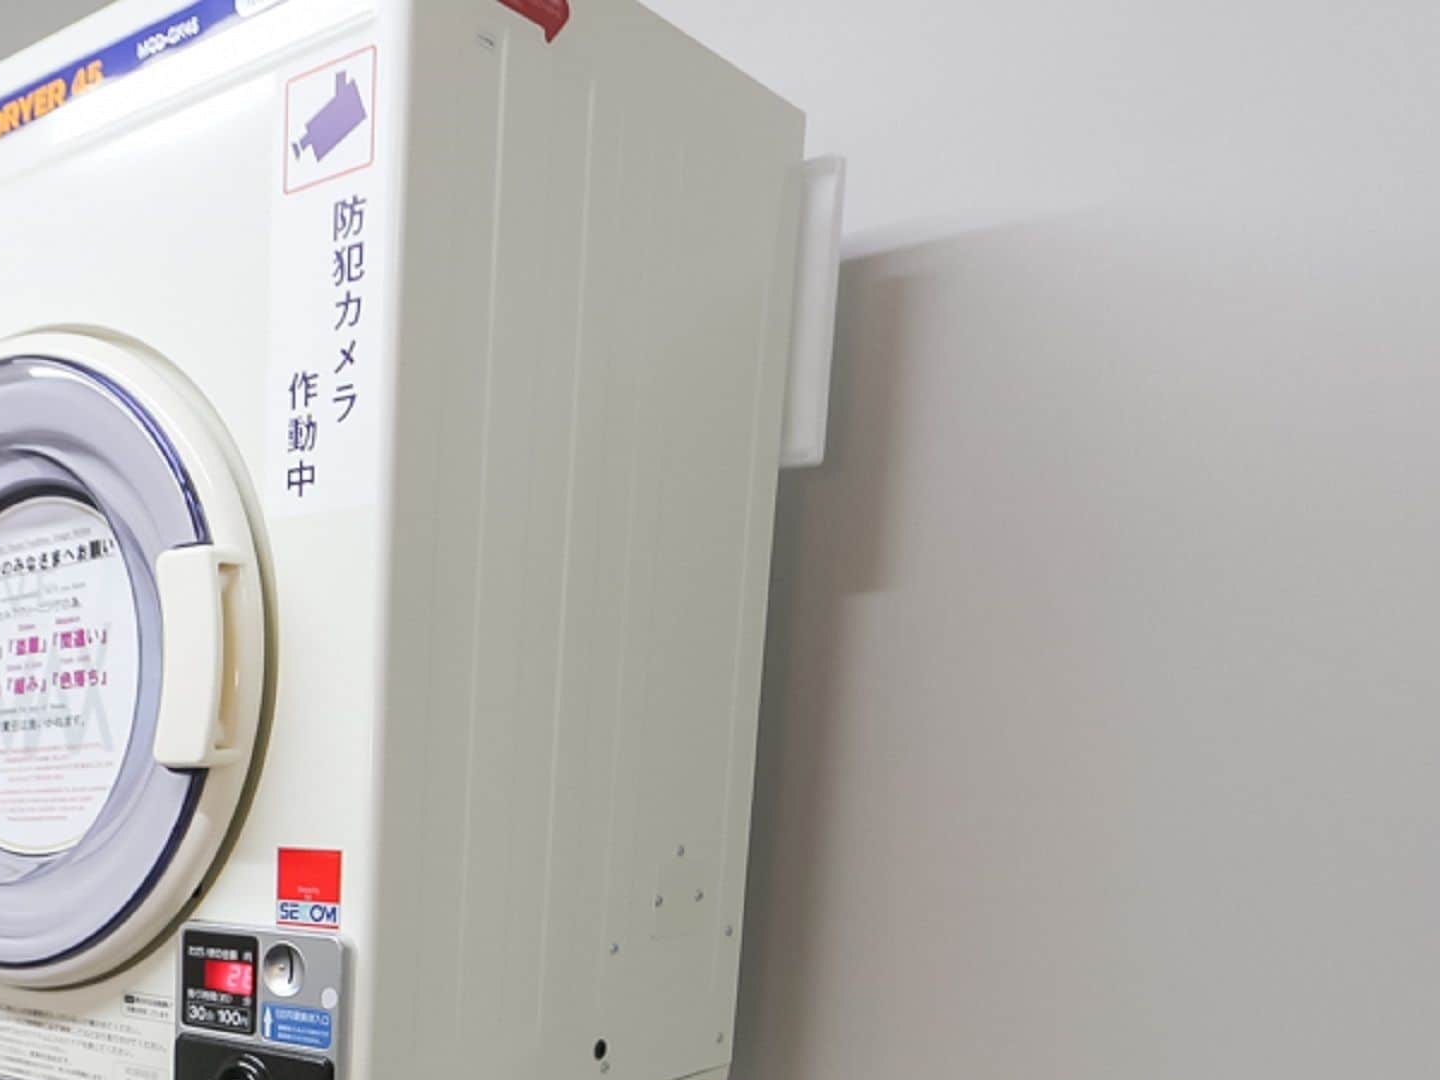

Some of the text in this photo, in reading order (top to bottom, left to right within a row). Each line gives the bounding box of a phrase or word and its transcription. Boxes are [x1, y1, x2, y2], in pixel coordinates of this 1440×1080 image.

[71, 58, 105, 97] 45
[332, 194, 366, 423] 防犯カメラ
[287, 370, 319, 499] 作動中
[279, 901, 337, 923] SEOM
